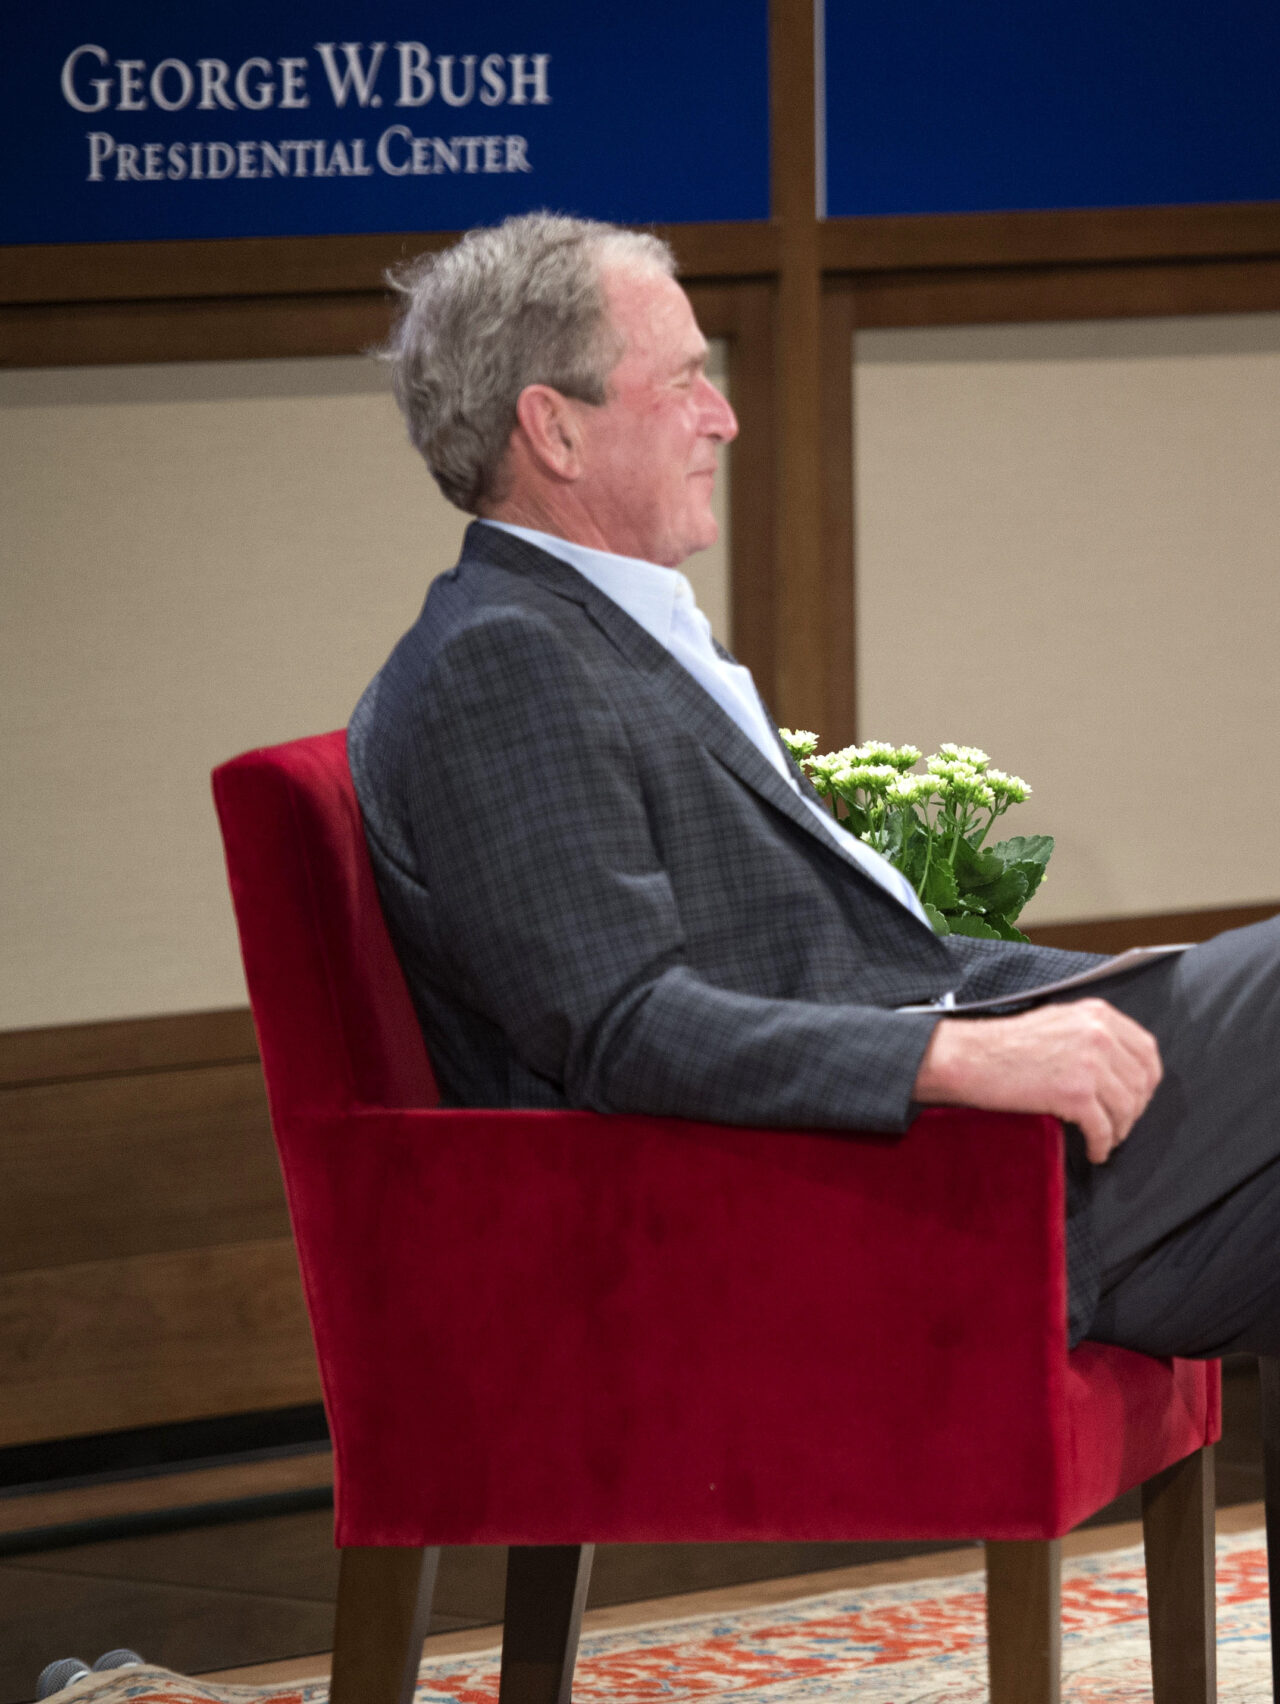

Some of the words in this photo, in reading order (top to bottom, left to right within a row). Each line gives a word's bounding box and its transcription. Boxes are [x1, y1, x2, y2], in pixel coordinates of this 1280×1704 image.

[60, 44, 309, 112] GEORGE
[313, 42, 385, 108] W.
[395, 41, 551, 107] BUSH
[85, 131, 372, 181] PRESIDENTIAL
[376, 125, 532, 175] CENTER
